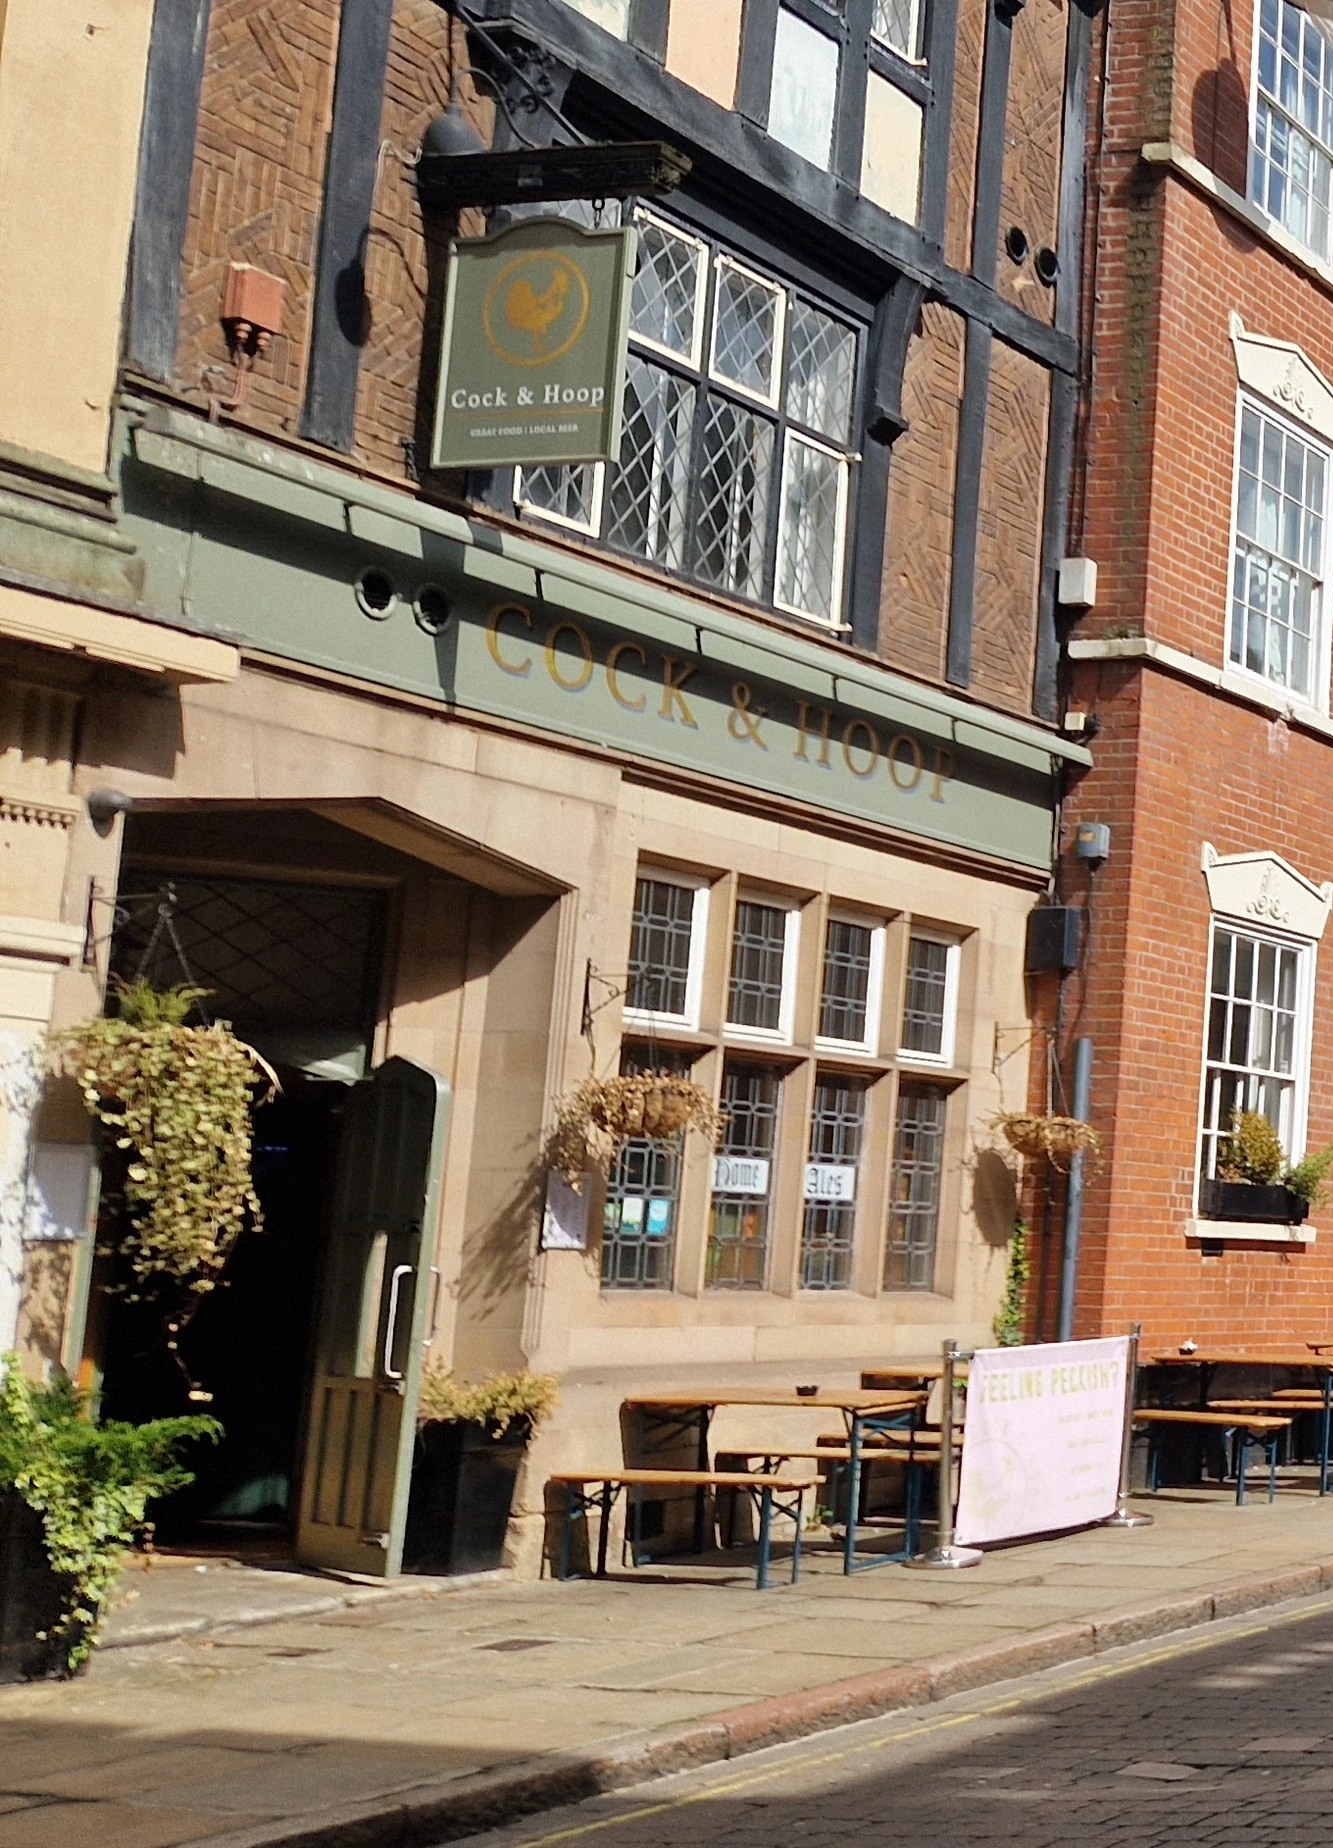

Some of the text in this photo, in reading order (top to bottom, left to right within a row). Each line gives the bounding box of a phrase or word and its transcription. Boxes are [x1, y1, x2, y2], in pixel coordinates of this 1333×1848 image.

[451, 384, 605, 408] Cock & Hoop
[470, 428, 497, 437] GREAT
[498, 426, 523, 436] FOOD
[529, 424, 557, 434] LOCAL
[485, 601, 956, 804] COCK & HOOP
[713, 1157, 761, 1189] Home
[806, 1167, 844, 1197] Ales
[979, 1360, 1120, 1404] FEELING PECKISH?
